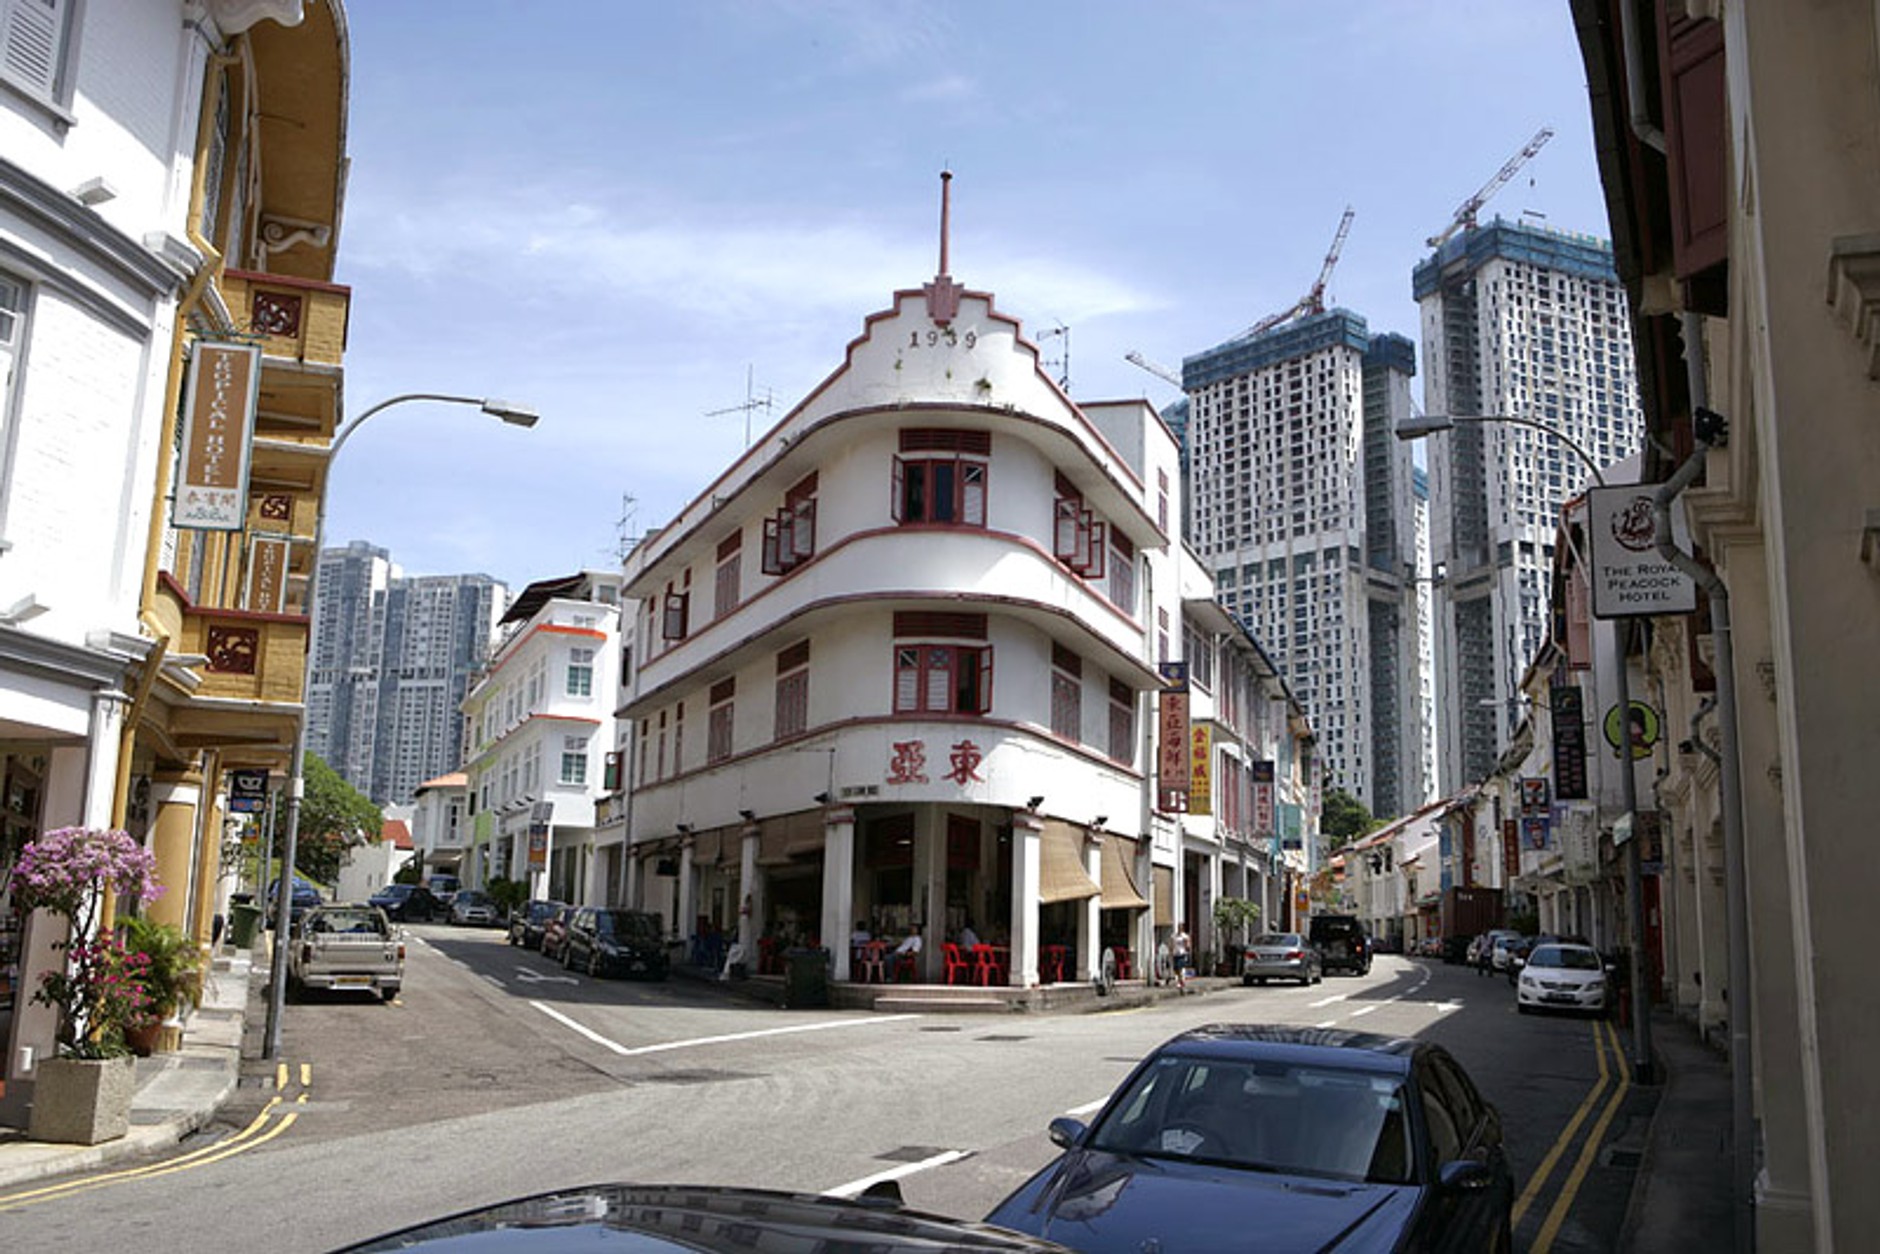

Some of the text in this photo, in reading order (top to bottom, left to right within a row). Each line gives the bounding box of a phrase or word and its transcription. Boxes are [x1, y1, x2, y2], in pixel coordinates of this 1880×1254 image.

[909, 329, 977, 349] 1939
[1603, 562, 1682, 577] THE ROYA
[1608, 577, 1681, 591] PEACOCK
[1619, 592, 1671, 603] HOTEL
